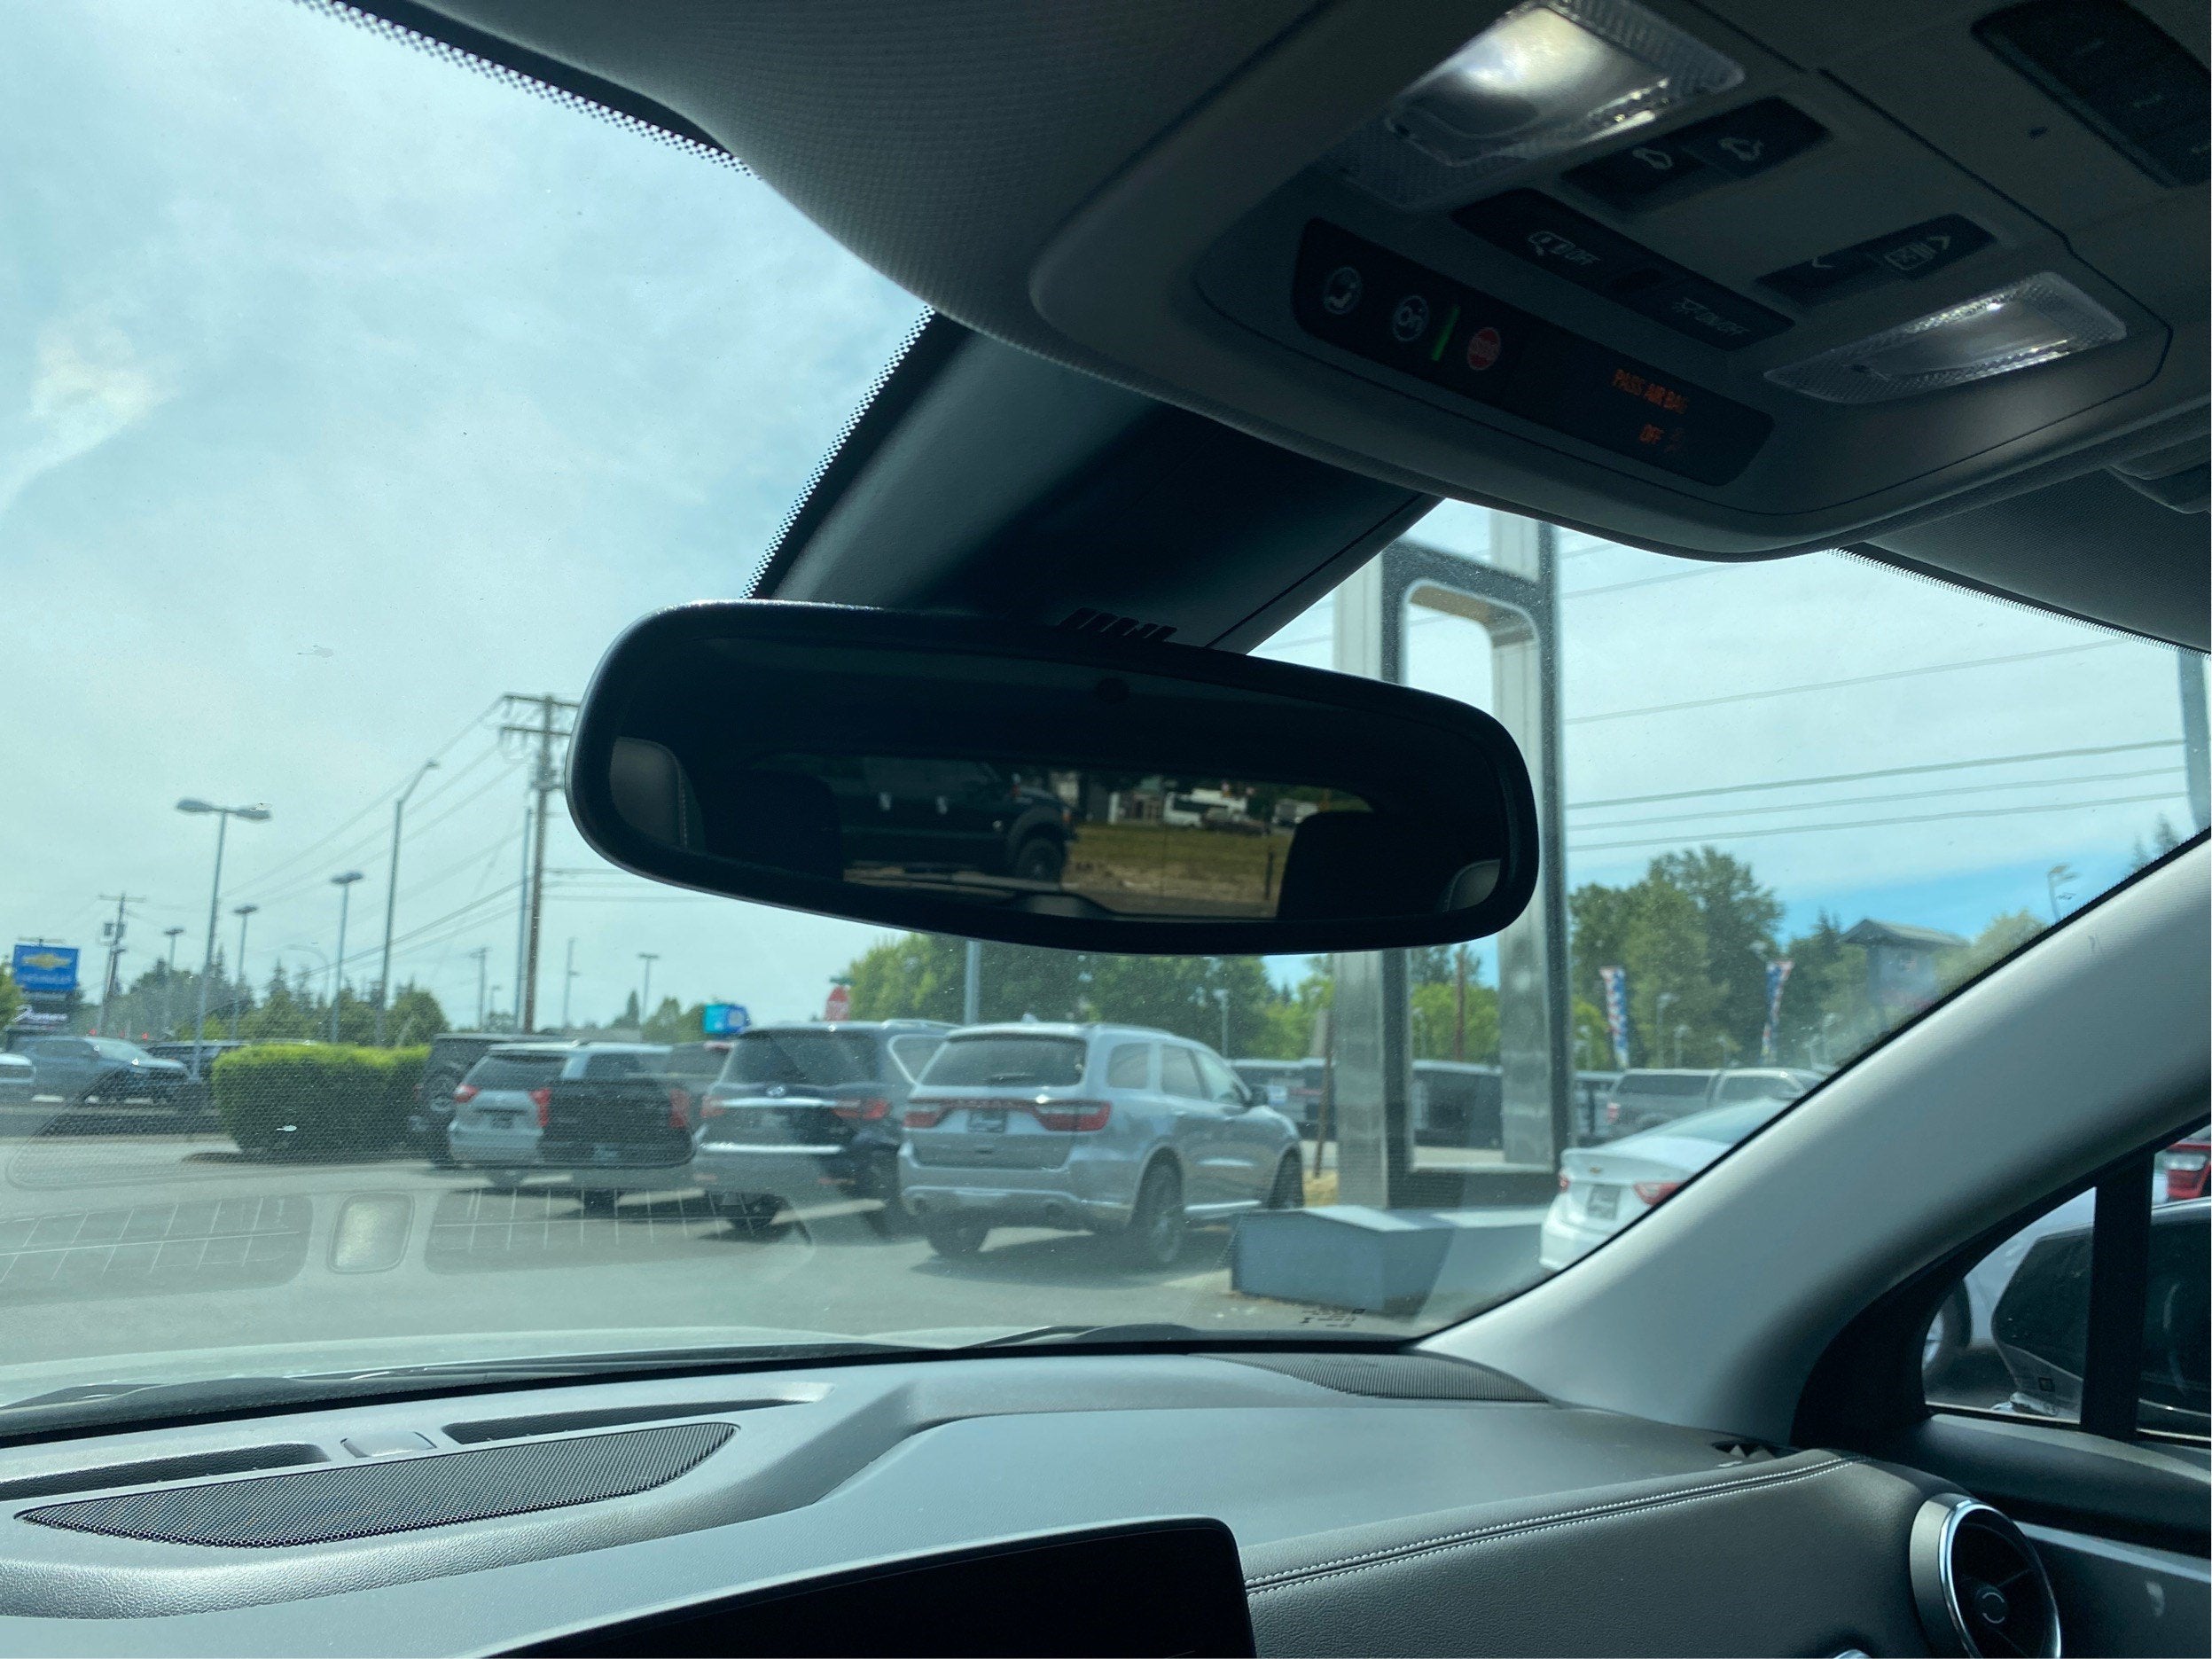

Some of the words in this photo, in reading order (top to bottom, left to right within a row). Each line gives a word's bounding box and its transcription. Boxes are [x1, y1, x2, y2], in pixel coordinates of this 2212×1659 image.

[1612, 369, 1645, 395] PASS
[1645, 383, 1666, 405] AIR
[1639, 424, 1665, 445] OFF
